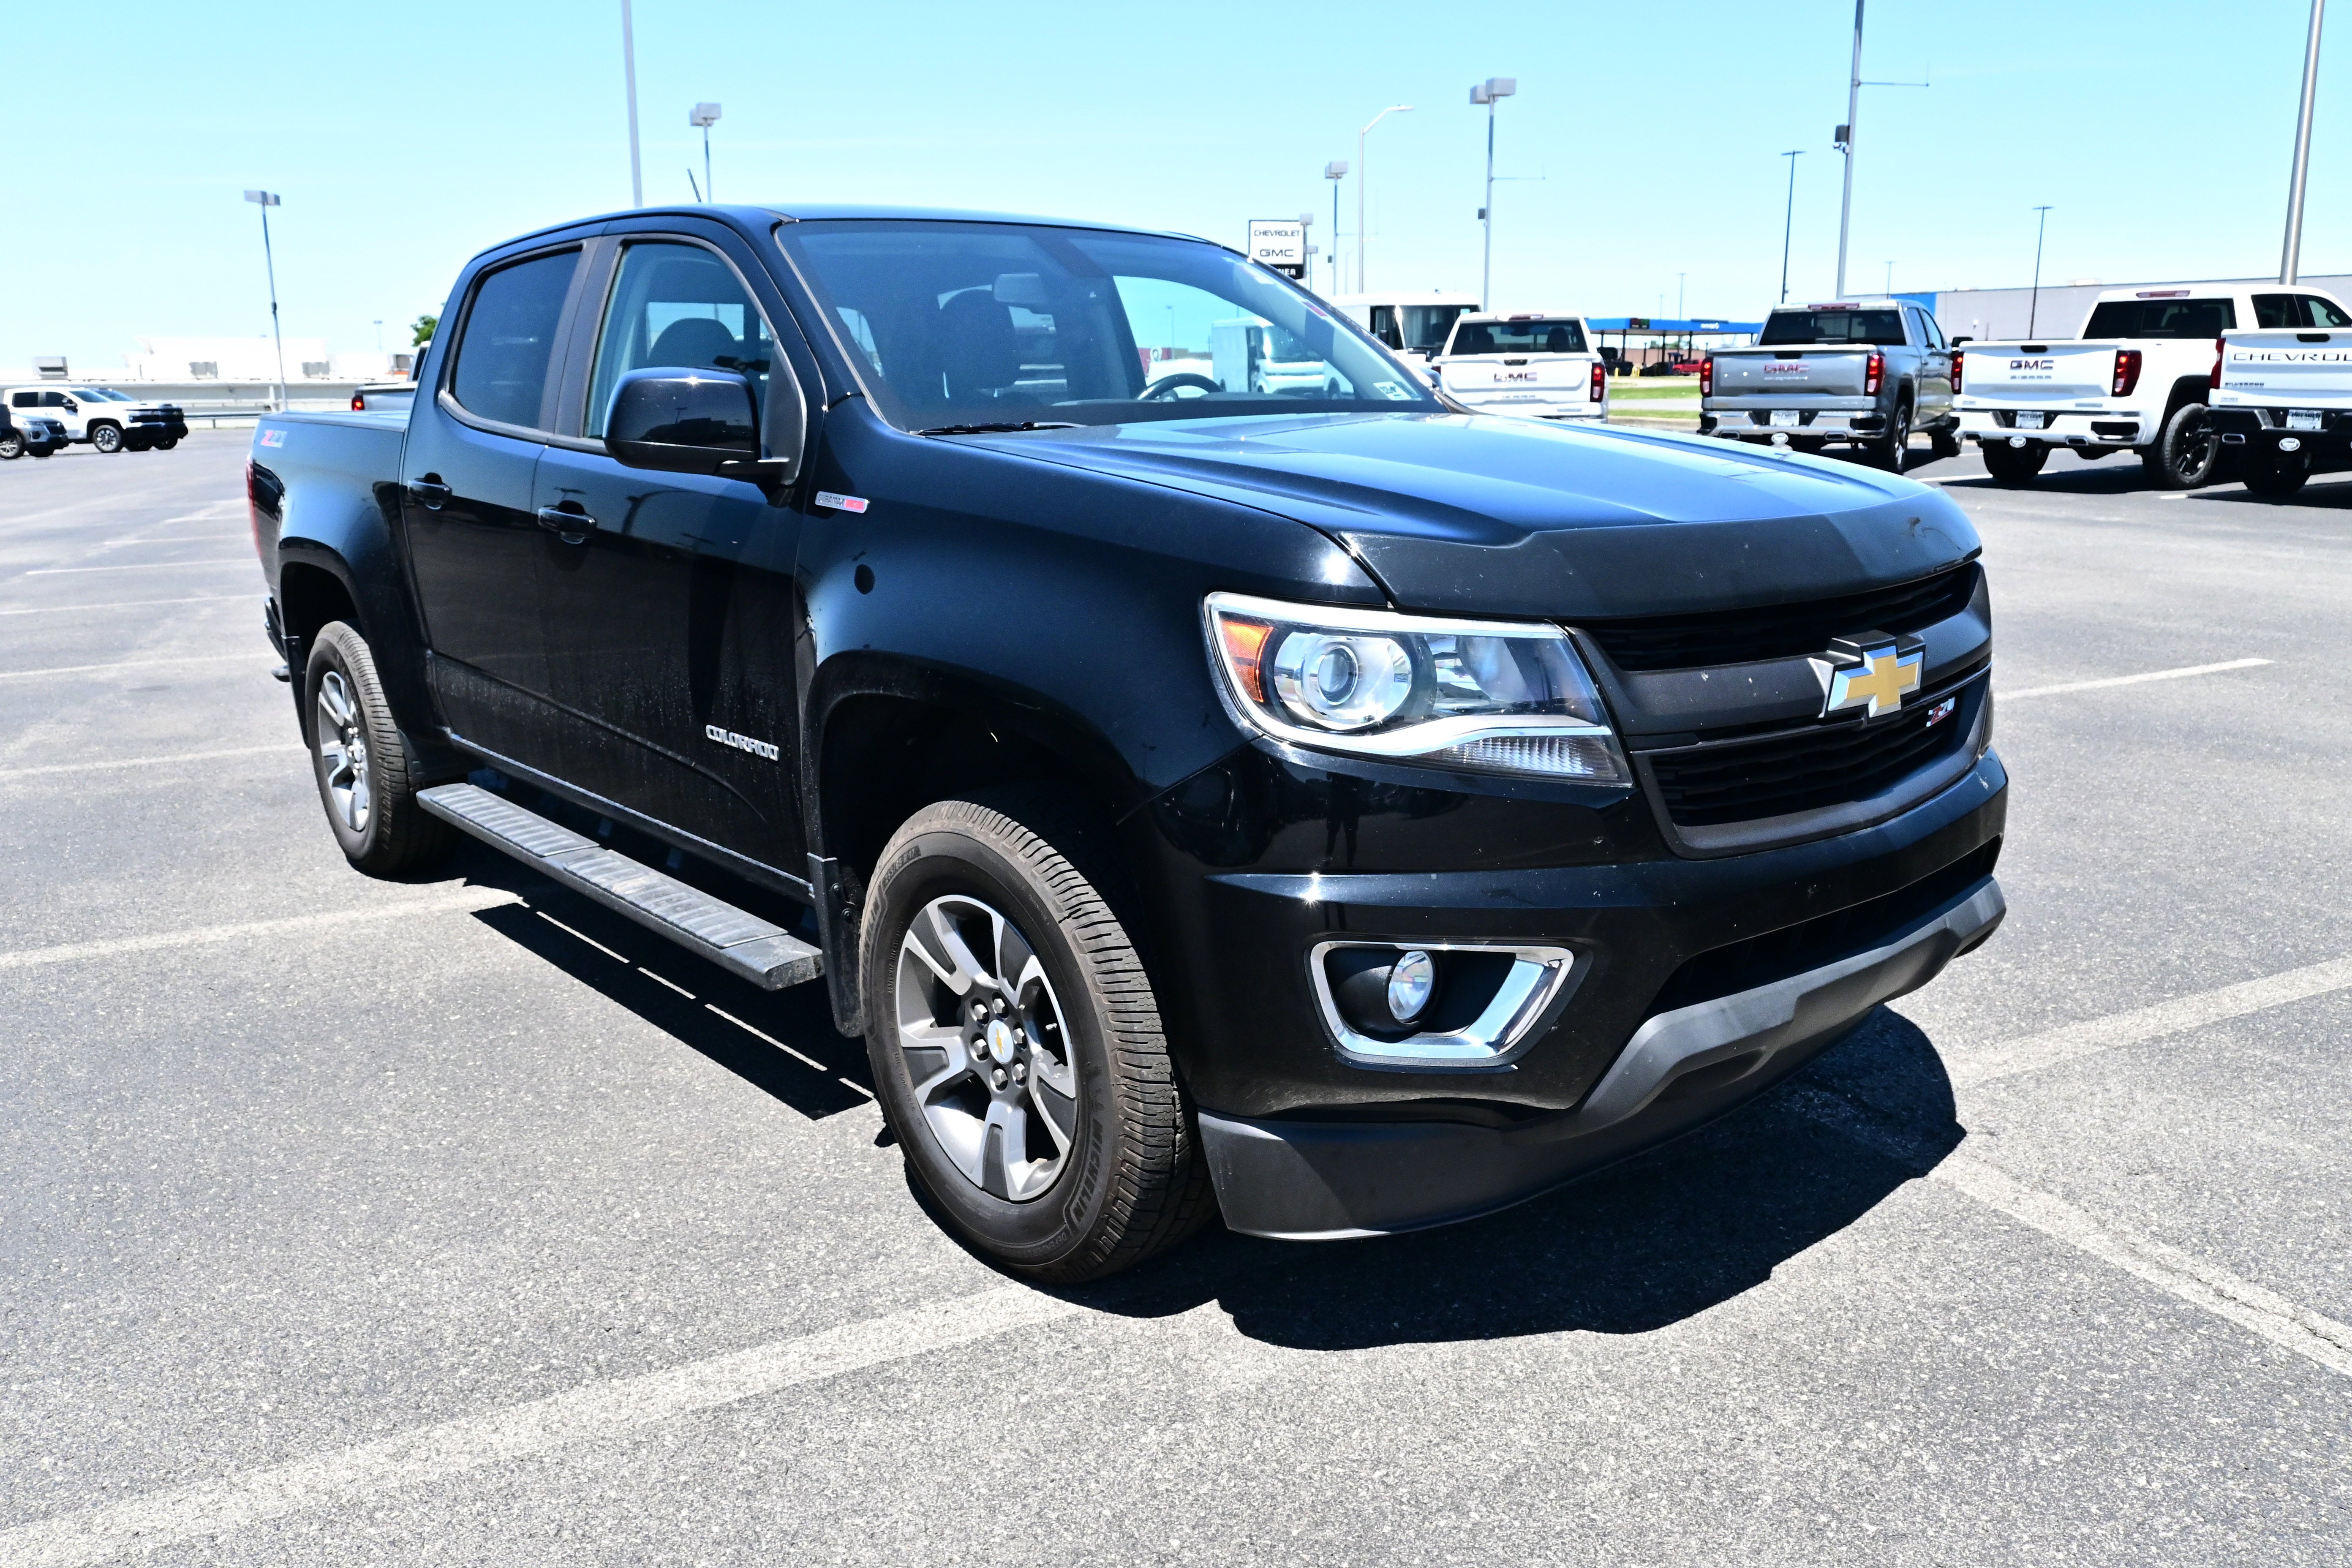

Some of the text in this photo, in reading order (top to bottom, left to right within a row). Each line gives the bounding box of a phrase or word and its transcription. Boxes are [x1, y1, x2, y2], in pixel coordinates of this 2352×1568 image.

[1764, 364, 1809, 373] GMC
[2010, 360, 2054, 370] GMC
[706, 724, 779, 761] COLORADO
[1073, 1118, 1103, 1223] MICHELIN
